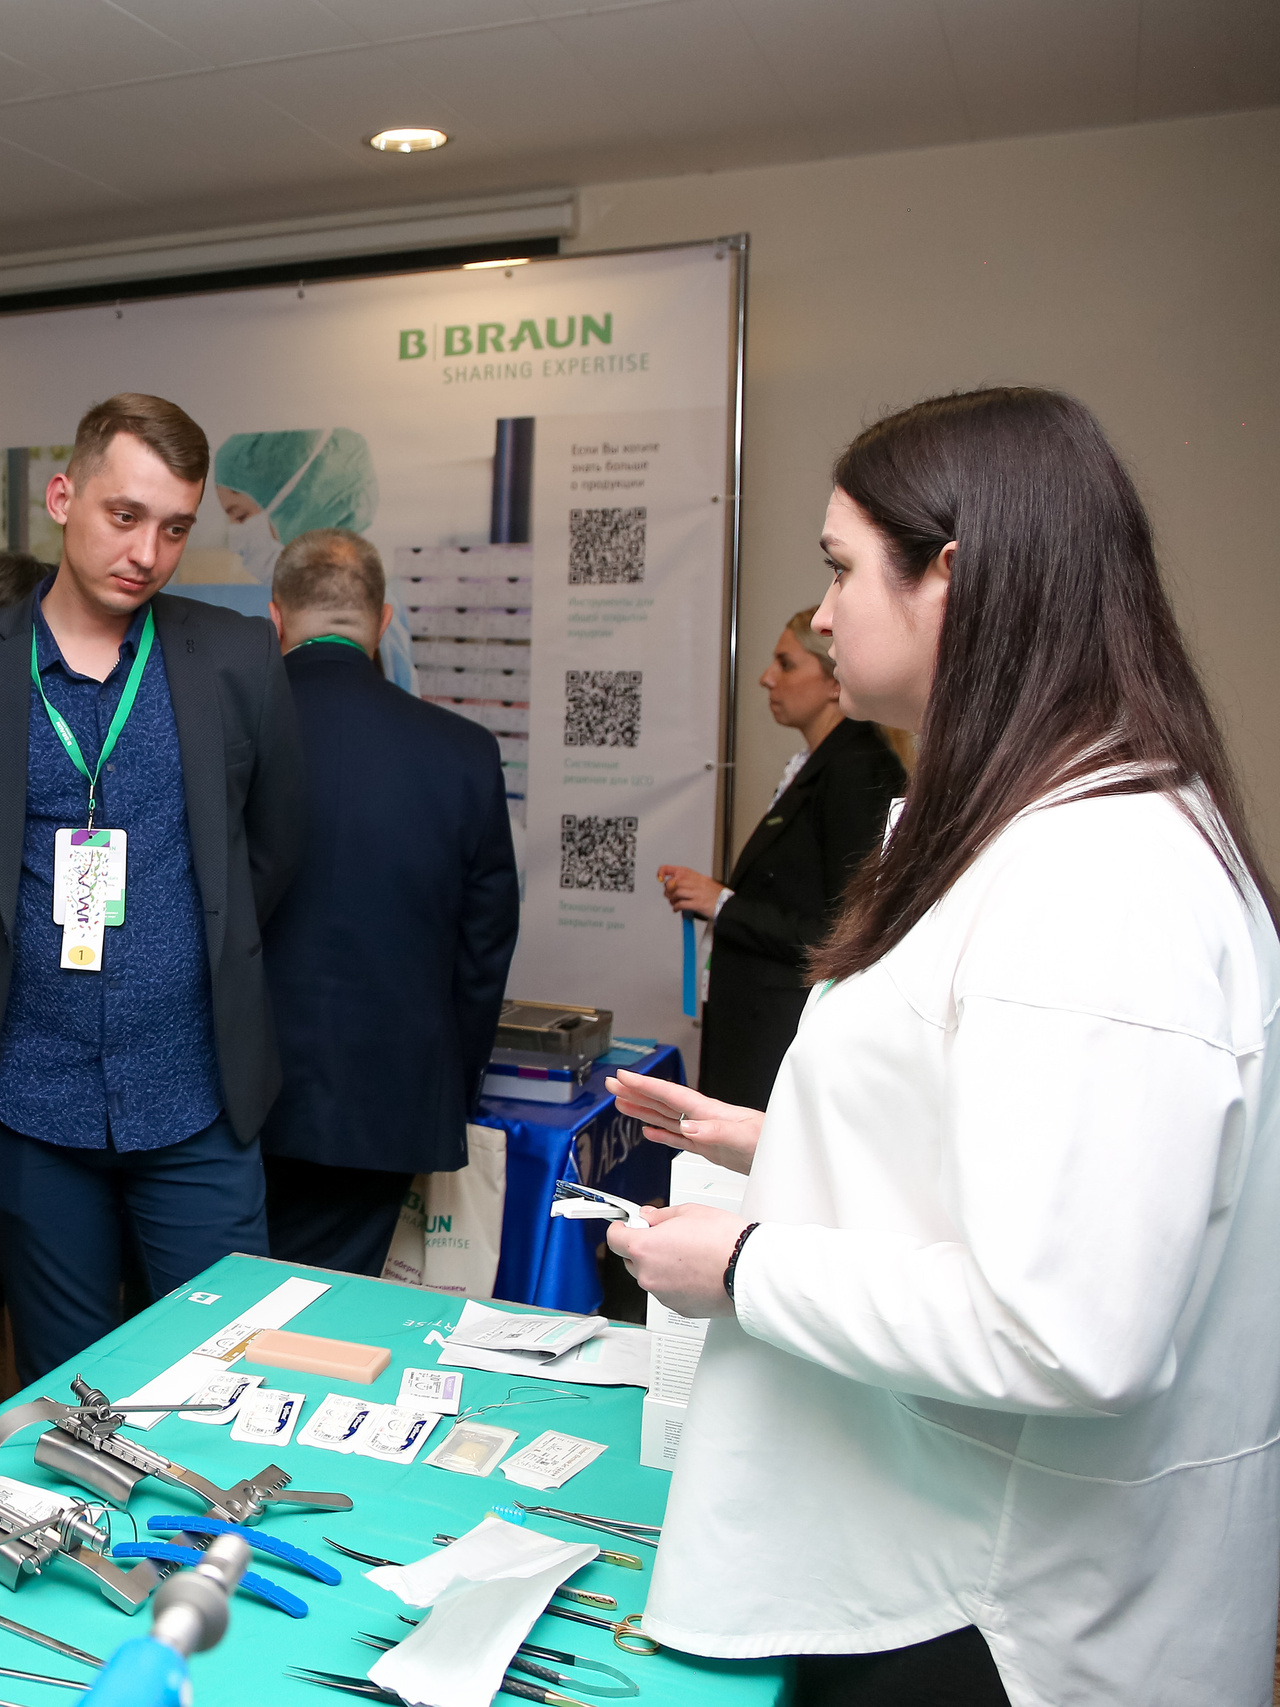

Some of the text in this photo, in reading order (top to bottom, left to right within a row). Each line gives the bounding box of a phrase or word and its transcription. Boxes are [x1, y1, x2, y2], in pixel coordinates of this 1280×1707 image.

[399, 312, 613, 360] B BRAUN
[443, 353, 650, 385] SHARING EXPERTISE
[78, 949, 84, 961] 1
[425, 1237, 470, 1249] XPERTISE
